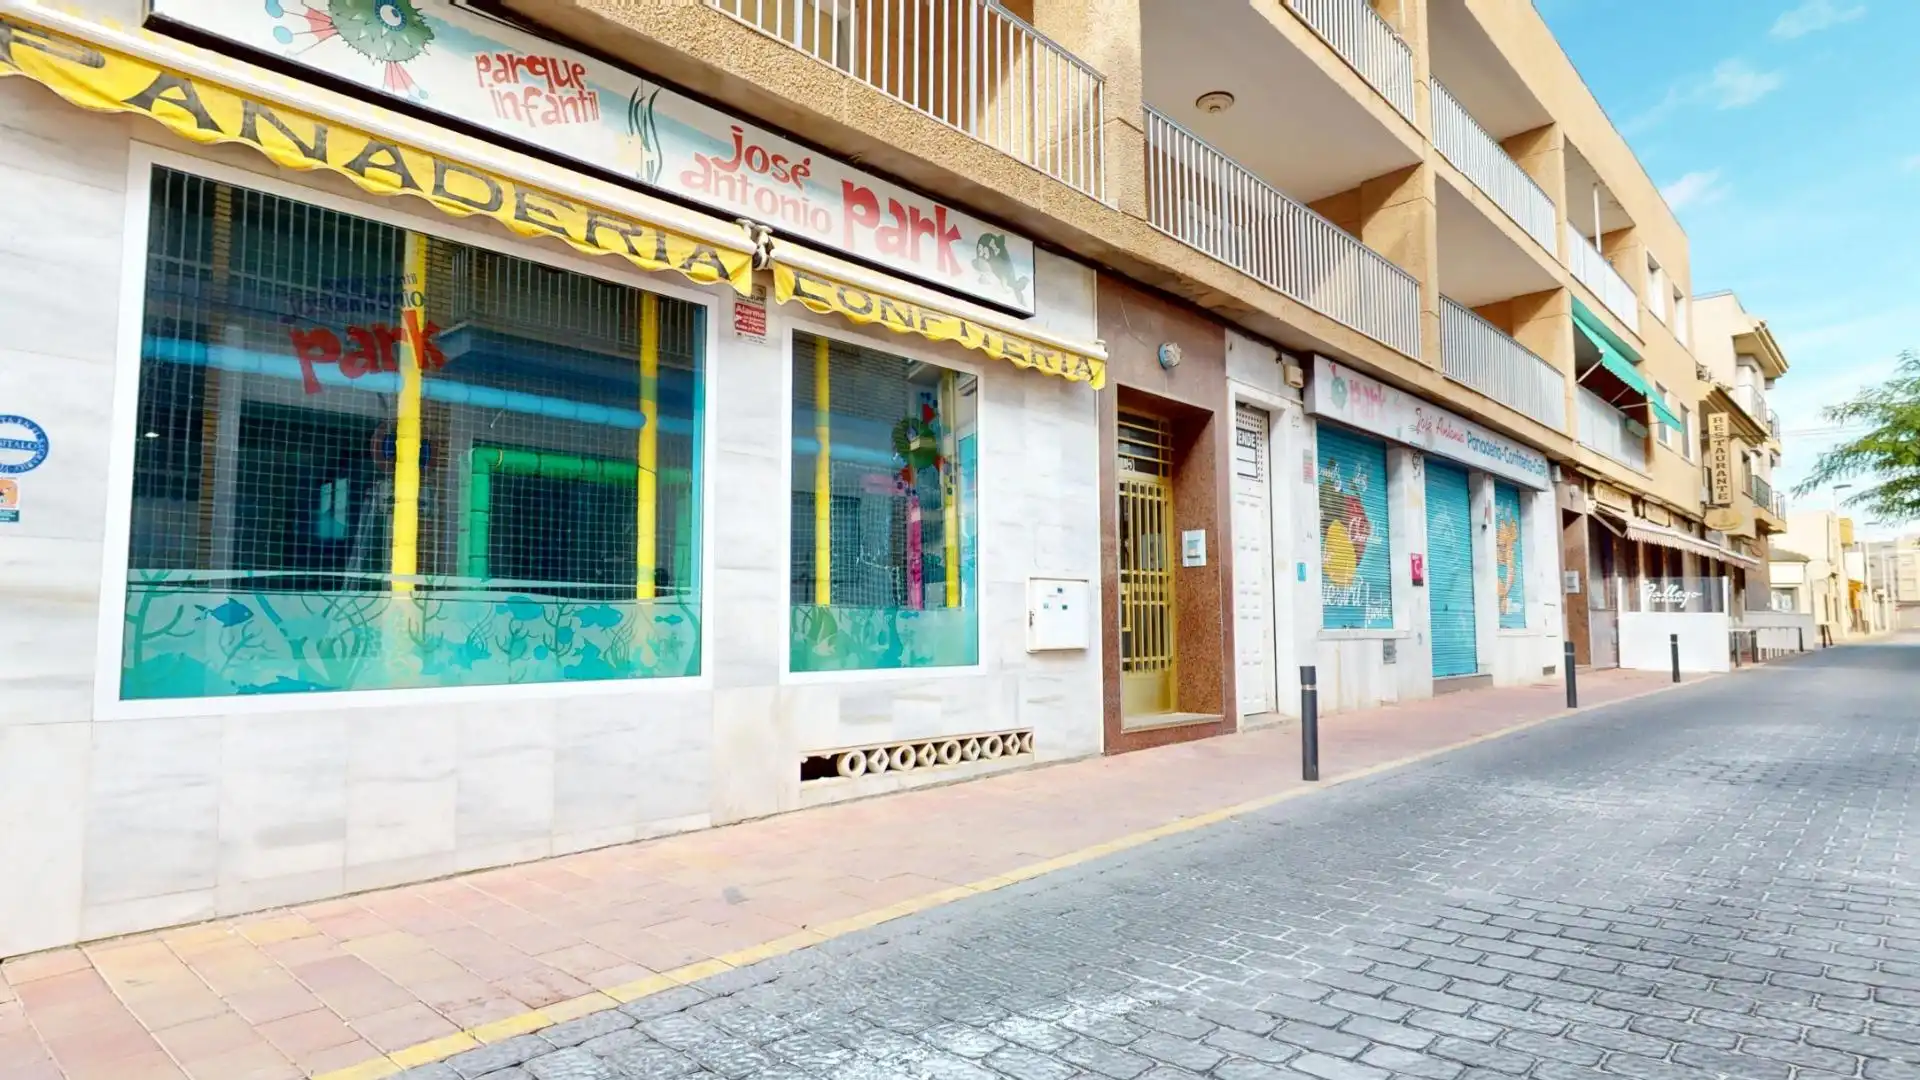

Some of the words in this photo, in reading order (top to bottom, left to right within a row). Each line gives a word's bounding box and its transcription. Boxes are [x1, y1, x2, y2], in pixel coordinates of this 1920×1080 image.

[475, 53, 586, 94] parque
[488, 83, 600, 128] infantil
[0, 19, 731, 281] PANADERIA
[710, 124, 812, 190] josé
[680, 151, 833, 234] antonio
[842, 180, 963, 276] park
[289, 310, 448, 396] park
[1236, 430, 1257, 448] ENDE
[1712, 416, 1729, 501] RESTAURANTE
